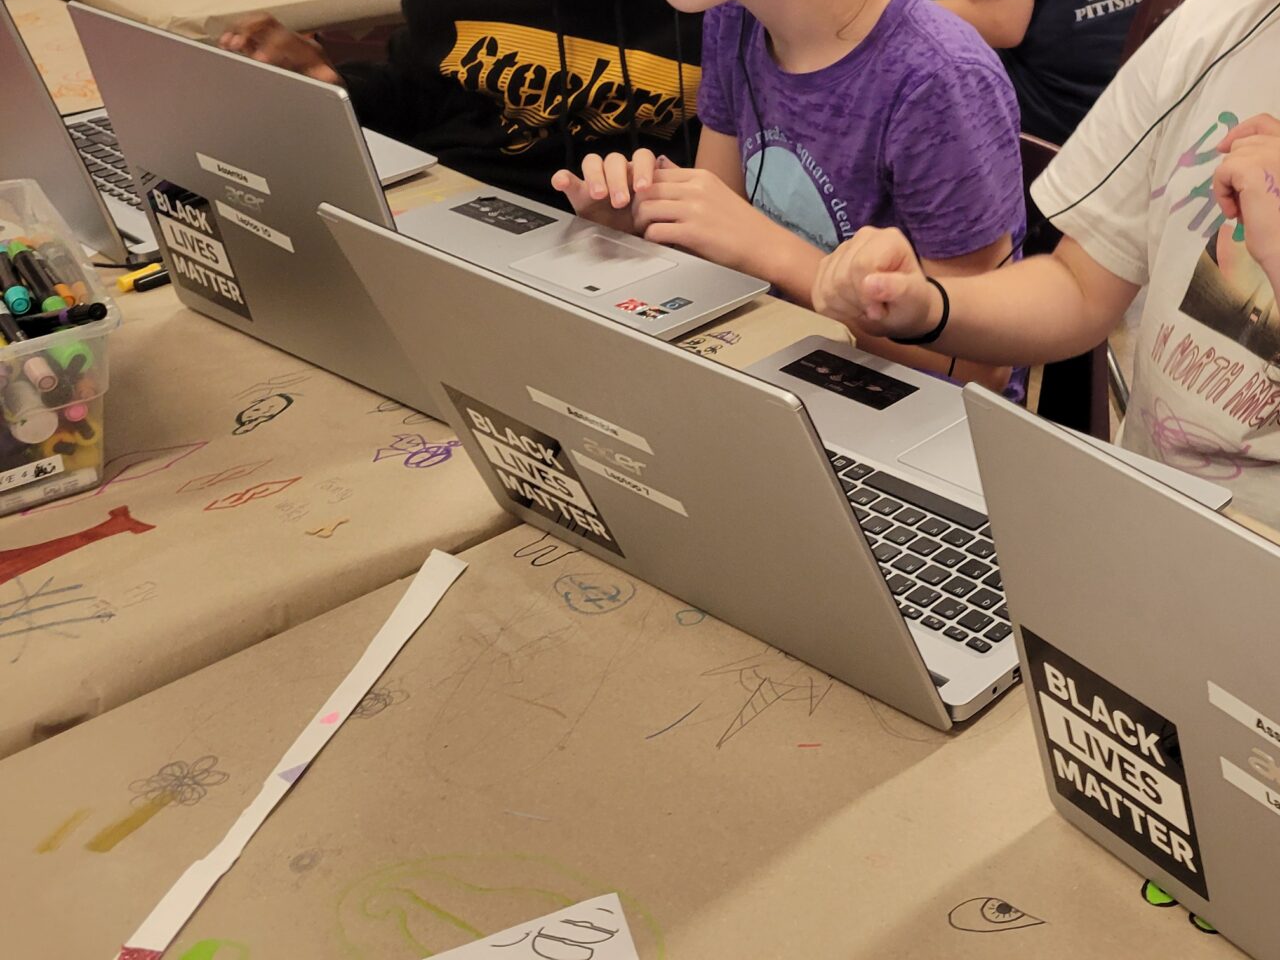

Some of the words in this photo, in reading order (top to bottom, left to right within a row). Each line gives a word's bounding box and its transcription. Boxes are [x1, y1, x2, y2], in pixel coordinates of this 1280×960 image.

[796, 143, 834, 194] square
[152, 188, 213, 234] BLACK
[169, 225, 220, 265] LIVES
[171, 253, 244, 305] MATTER
[1151, 322, 1175, 364] IN
[1163, 333, 1245, 404] NORTH
[466, 407, 566, 471] BLACK
[493, 444, 575, 499] LIVES
[497, 469, 612, 542] MATTER
[1043, 661, 1166, 768] BLACK
[1063, 714, 1163, 806] LIVES
[1052, 747, 1198, 874] MATTER
